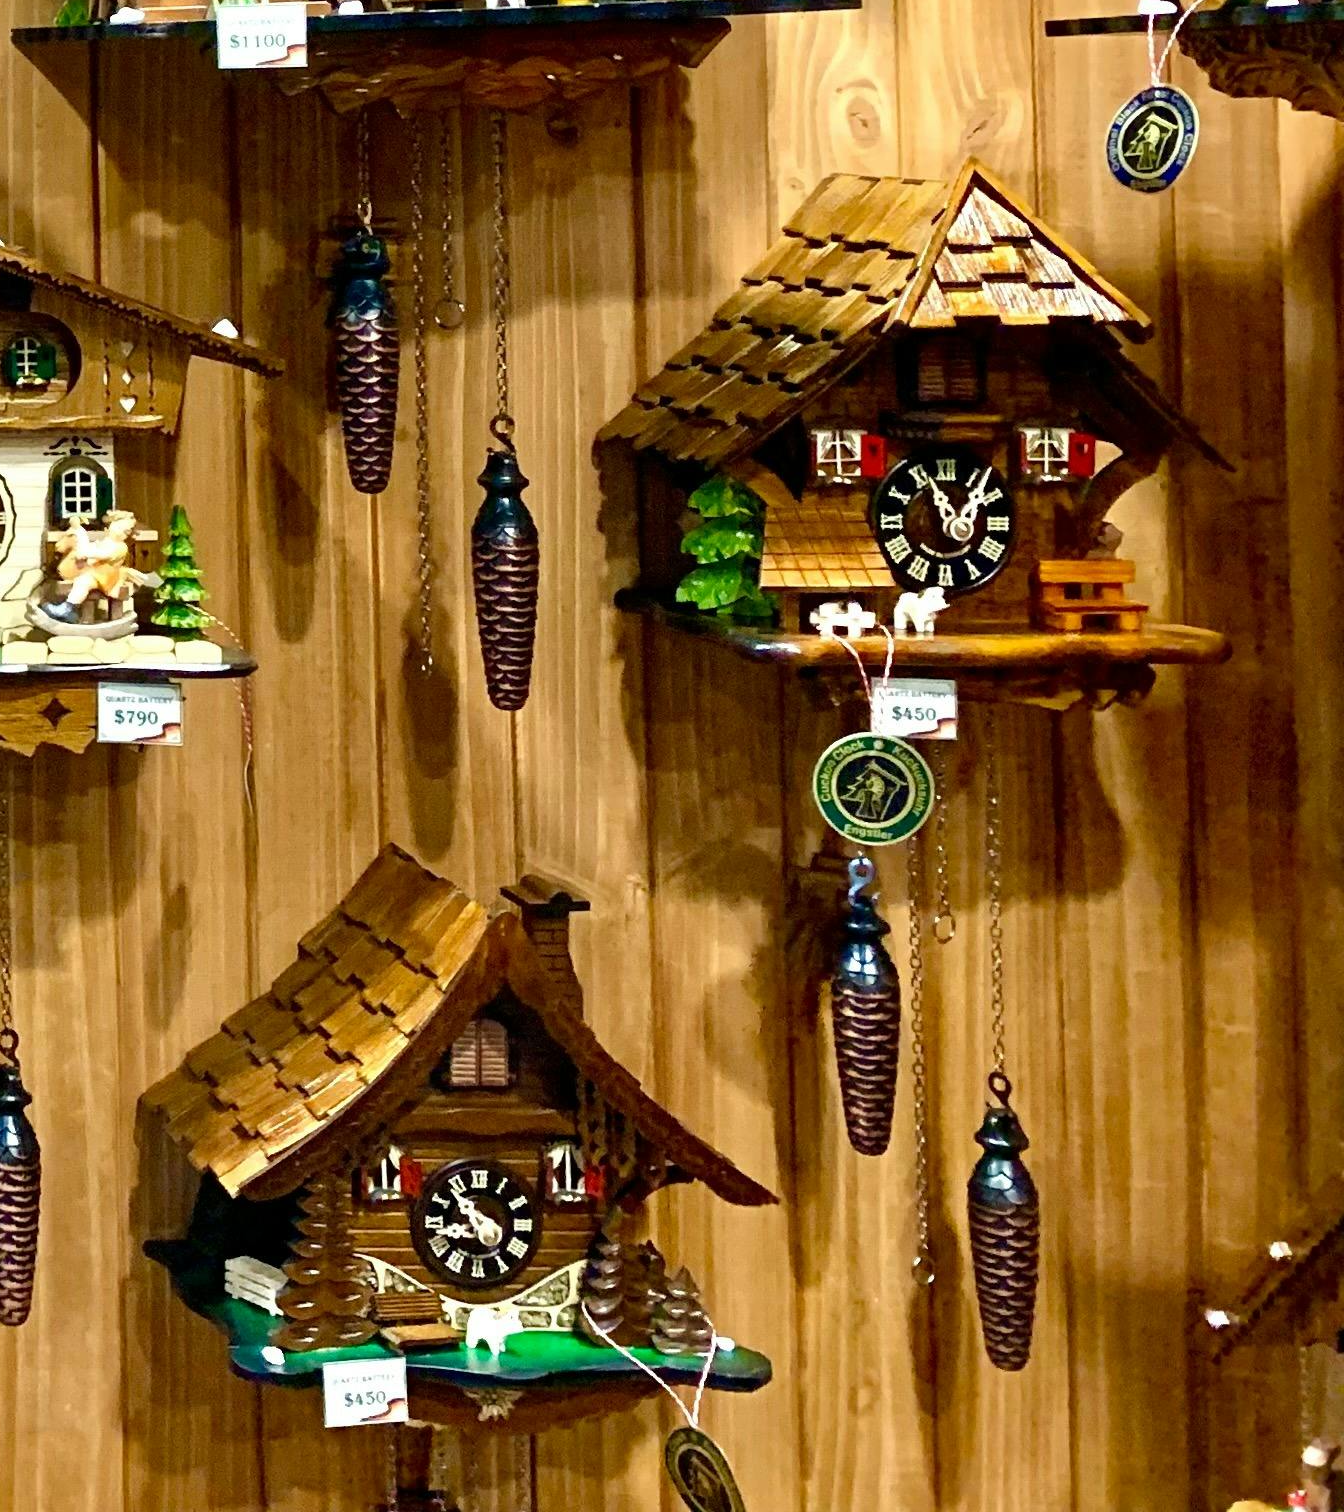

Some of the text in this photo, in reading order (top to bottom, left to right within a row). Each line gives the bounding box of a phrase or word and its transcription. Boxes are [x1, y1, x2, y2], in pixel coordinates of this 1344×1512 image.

[230, 34, 286, 49] $1100
[114, 711, 158, 725] $790
[892, 706, 936, 722] $450
[821, 740, 865, 802] Cuckoo Clock
[892, 746, 927, 816] Kuckucksuhr
[844, 824, 893, 839] Engstler
[344, 1391, 386, 1406] $450
